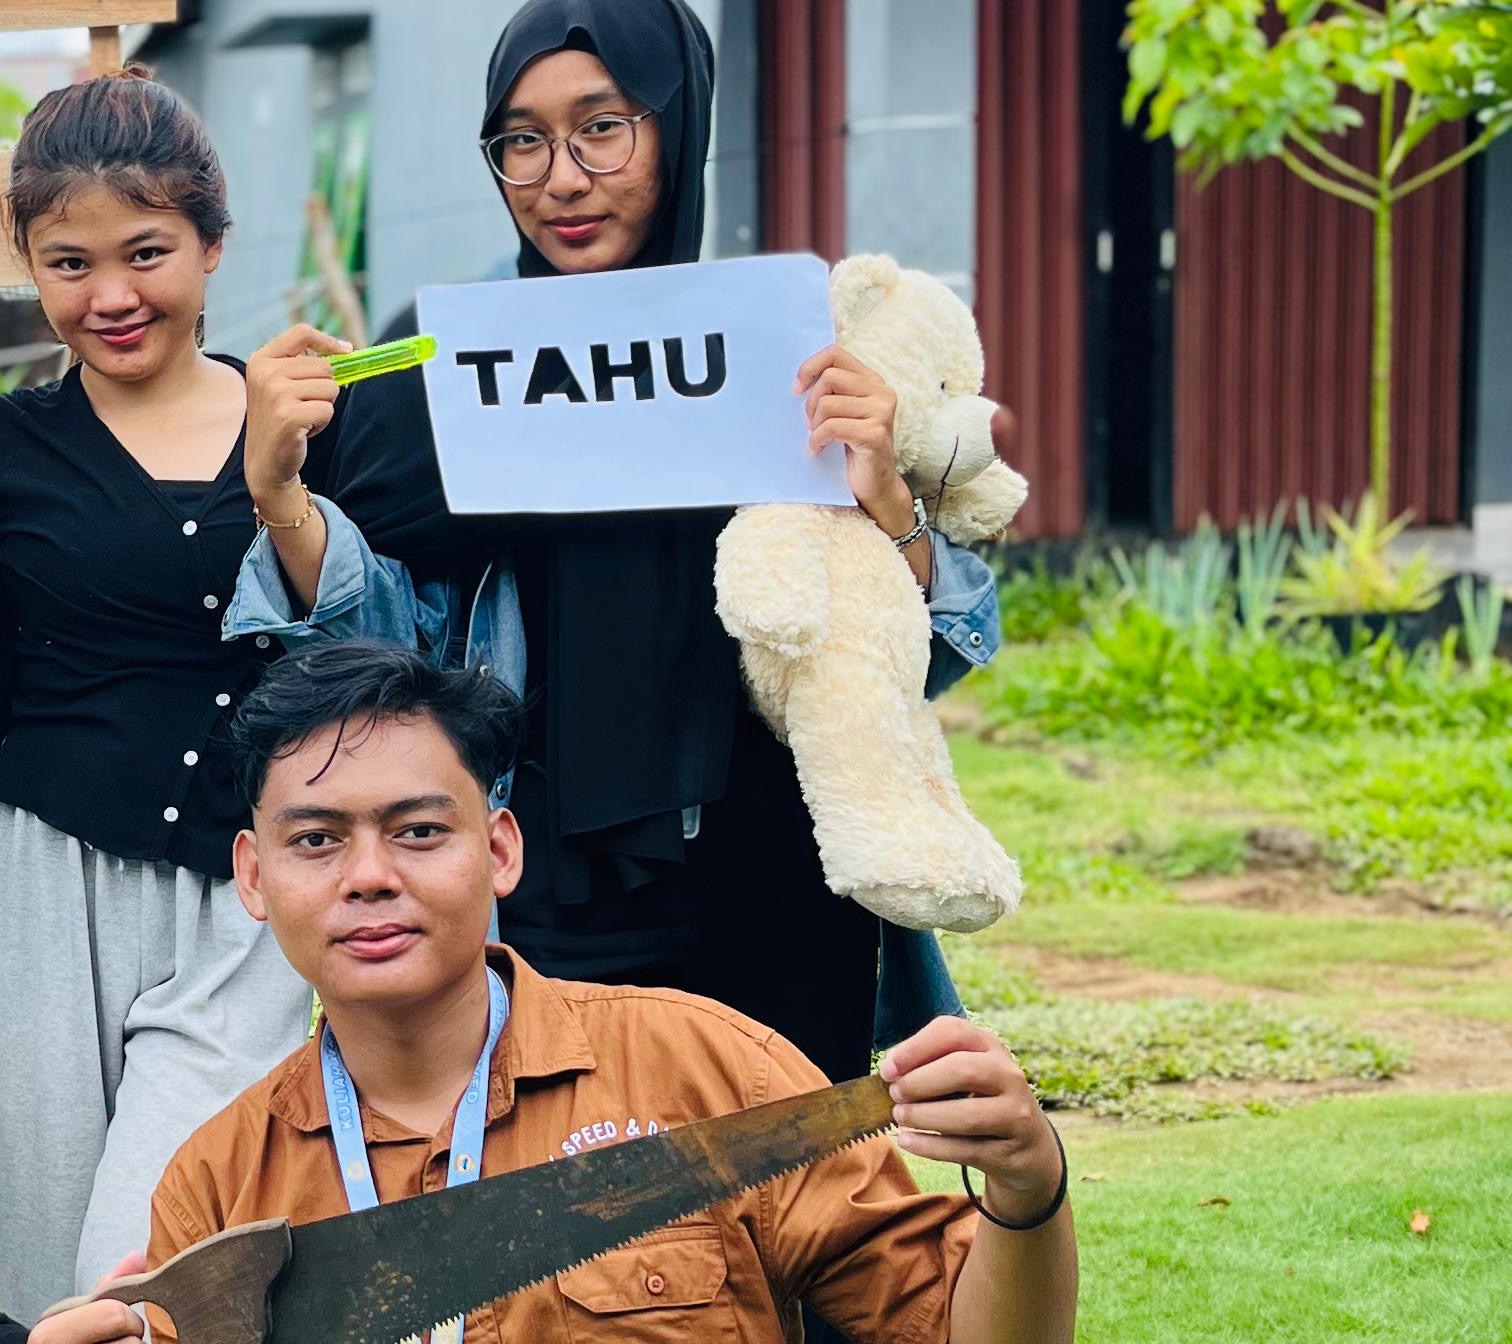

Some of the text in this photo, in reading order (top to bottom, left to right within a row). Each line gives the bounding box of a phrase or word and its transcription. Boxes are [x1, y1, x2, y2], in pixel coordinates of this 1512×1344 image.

[455, 332, 728, 406] TAHU
[561, 1120, 618, 1156] SPEED
[625, 1118, 641, 1136] &
